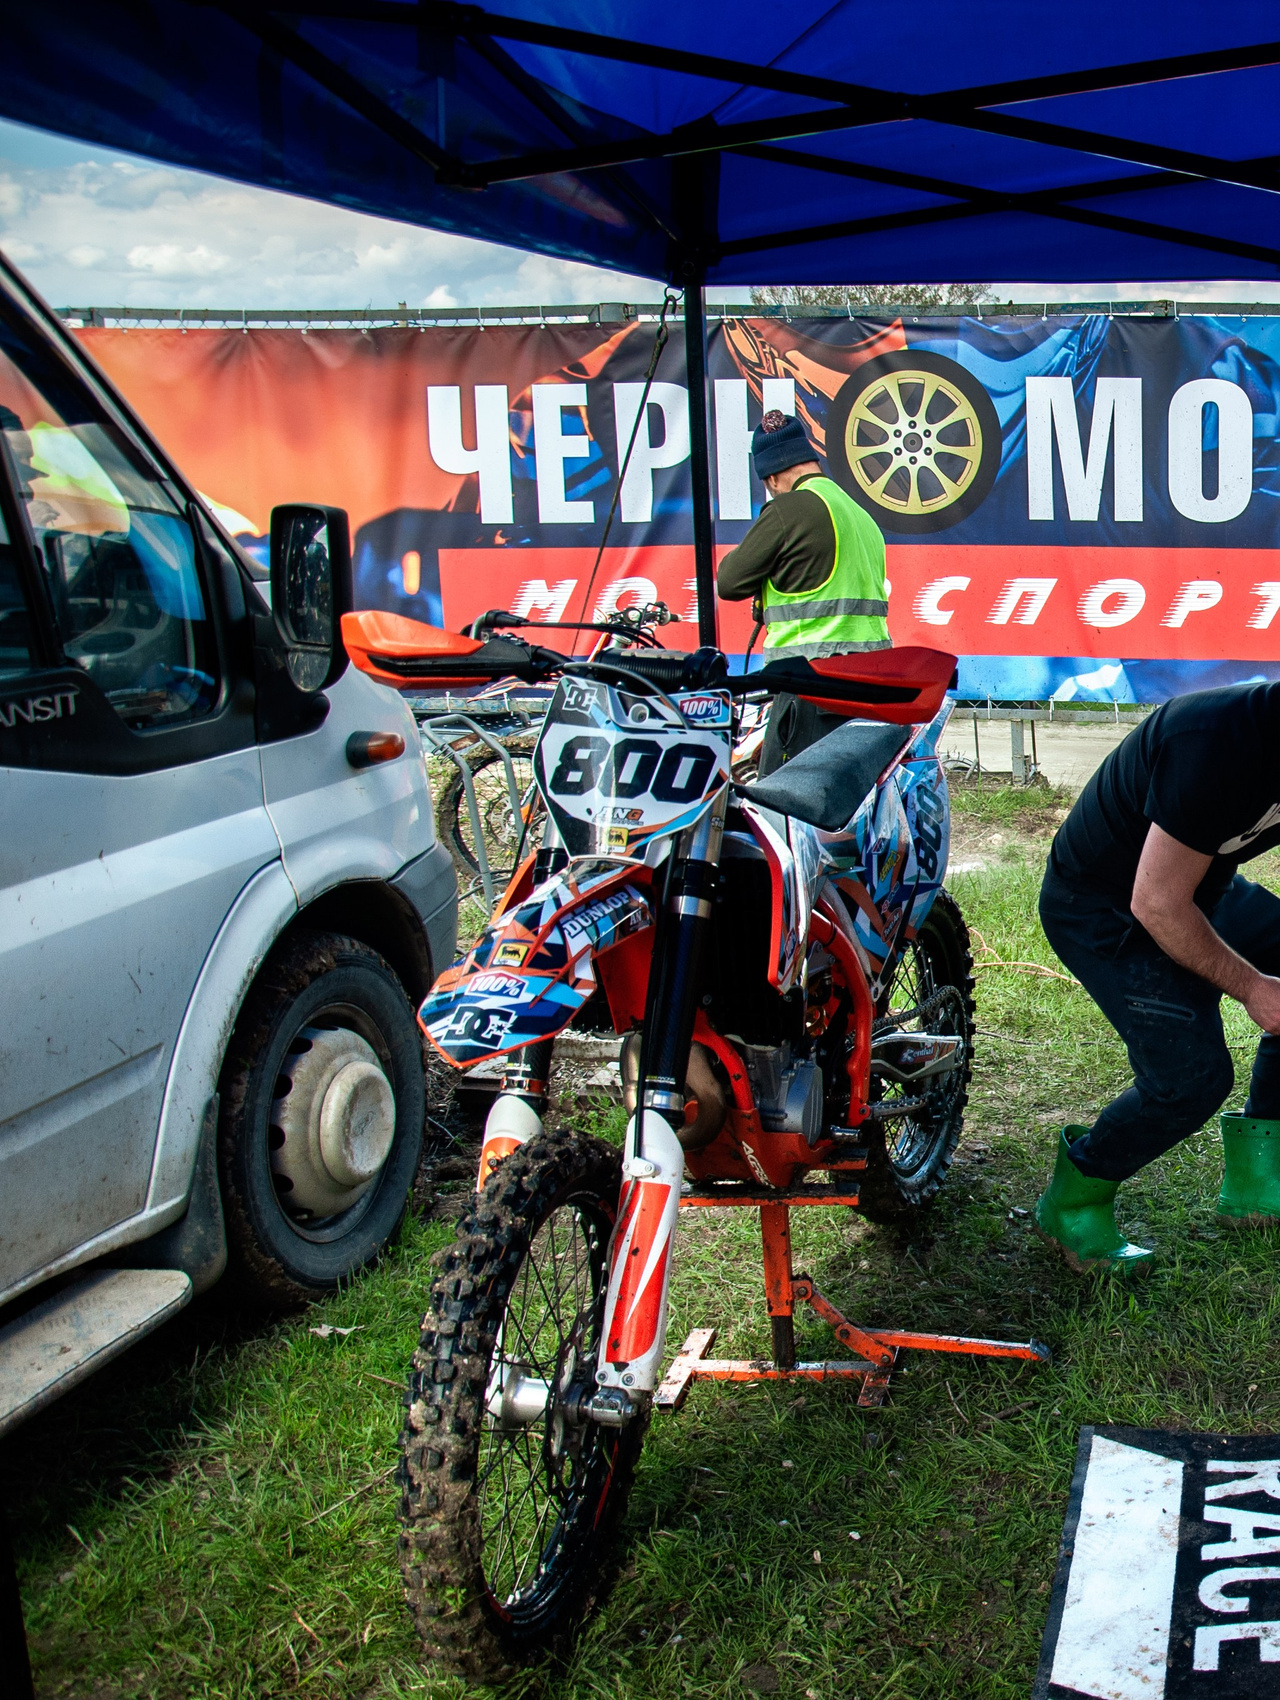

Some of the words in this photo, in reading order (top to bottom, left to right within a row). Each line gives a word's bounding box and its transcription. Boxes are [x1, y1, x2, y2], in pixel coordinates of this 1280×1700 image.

[682, 699, 719, 717] 100%
[549, 735, 718, 805] 800
[916, 783, 945, 882] 800
[562, 891, 630, 938] DUNLOP
[470, 975, 522, 997] 100%
